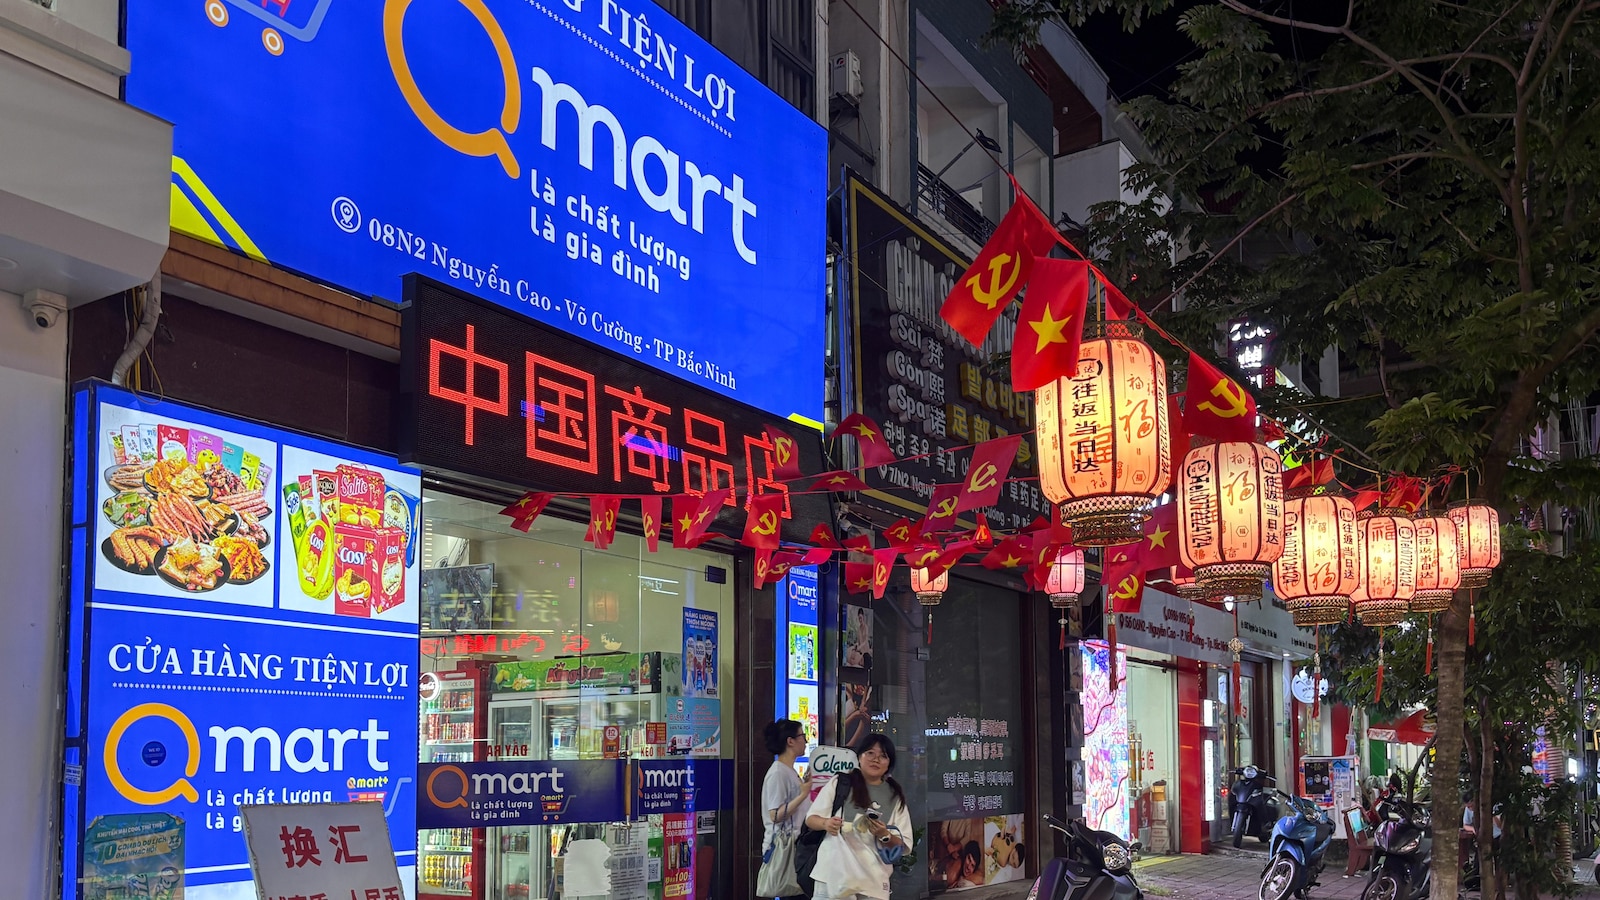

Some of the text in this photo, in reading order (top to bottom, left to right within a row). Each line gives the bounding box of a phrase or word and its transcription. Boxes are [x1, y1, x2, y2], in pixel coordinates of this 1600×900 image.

[597, 0, 738, 122] TIỆN LỢI
[530, 169, 690, 281] là chất lượng
[530, 207, 660, 294] là gia đình
[368, 217, 428, 262] 08N2
[432, 245, 511, 295] Nguyễn
[516, 280, 552, 312] Cao
[564, 298, 588, 328] Võ
[591, 313, 643, 354] Cường
[654, 339, 675, 365] TP
[677, 348, 703, 378] Bắc
[704, 361, 738, 390] Ninh
[894, 314, 922, 349] Sài
[893, 350, 925, 387] Gòn
[967, 364, 983, 402] 발
[985, 378, 998, 410] &
[894, 385, 927, 422] Spa
[1072, 382, 1101, 473] 往返当日达
[340, 476, 368, 496] Solite
[1264, 475, 1279, 544] 往返当日达
[309, 532, 325, 551] COSY
[339, 547, 367, 566] COSY
[1342, 523, 1355, 580] 往返当日达
[789, 580, 817, 599] Qmart
[108, 637, 409, 694] CỬA HÀNG TIỆN LỢI
[103, 702, 390, 806] Qmart
[813, 754, 854, 774] Celano
[207, 790, 226, 807] là
[233, 786, 275, 806] chất
[427, 765, 565, 809] Qmart
[471, 800, 533, 811] là chất lượng
[206, 812, 226, 830] là
[471, 810, 521, 821] là gia đình
[96, 842, 118, 863] 10
[279, 825, 369, 869] 换汇
